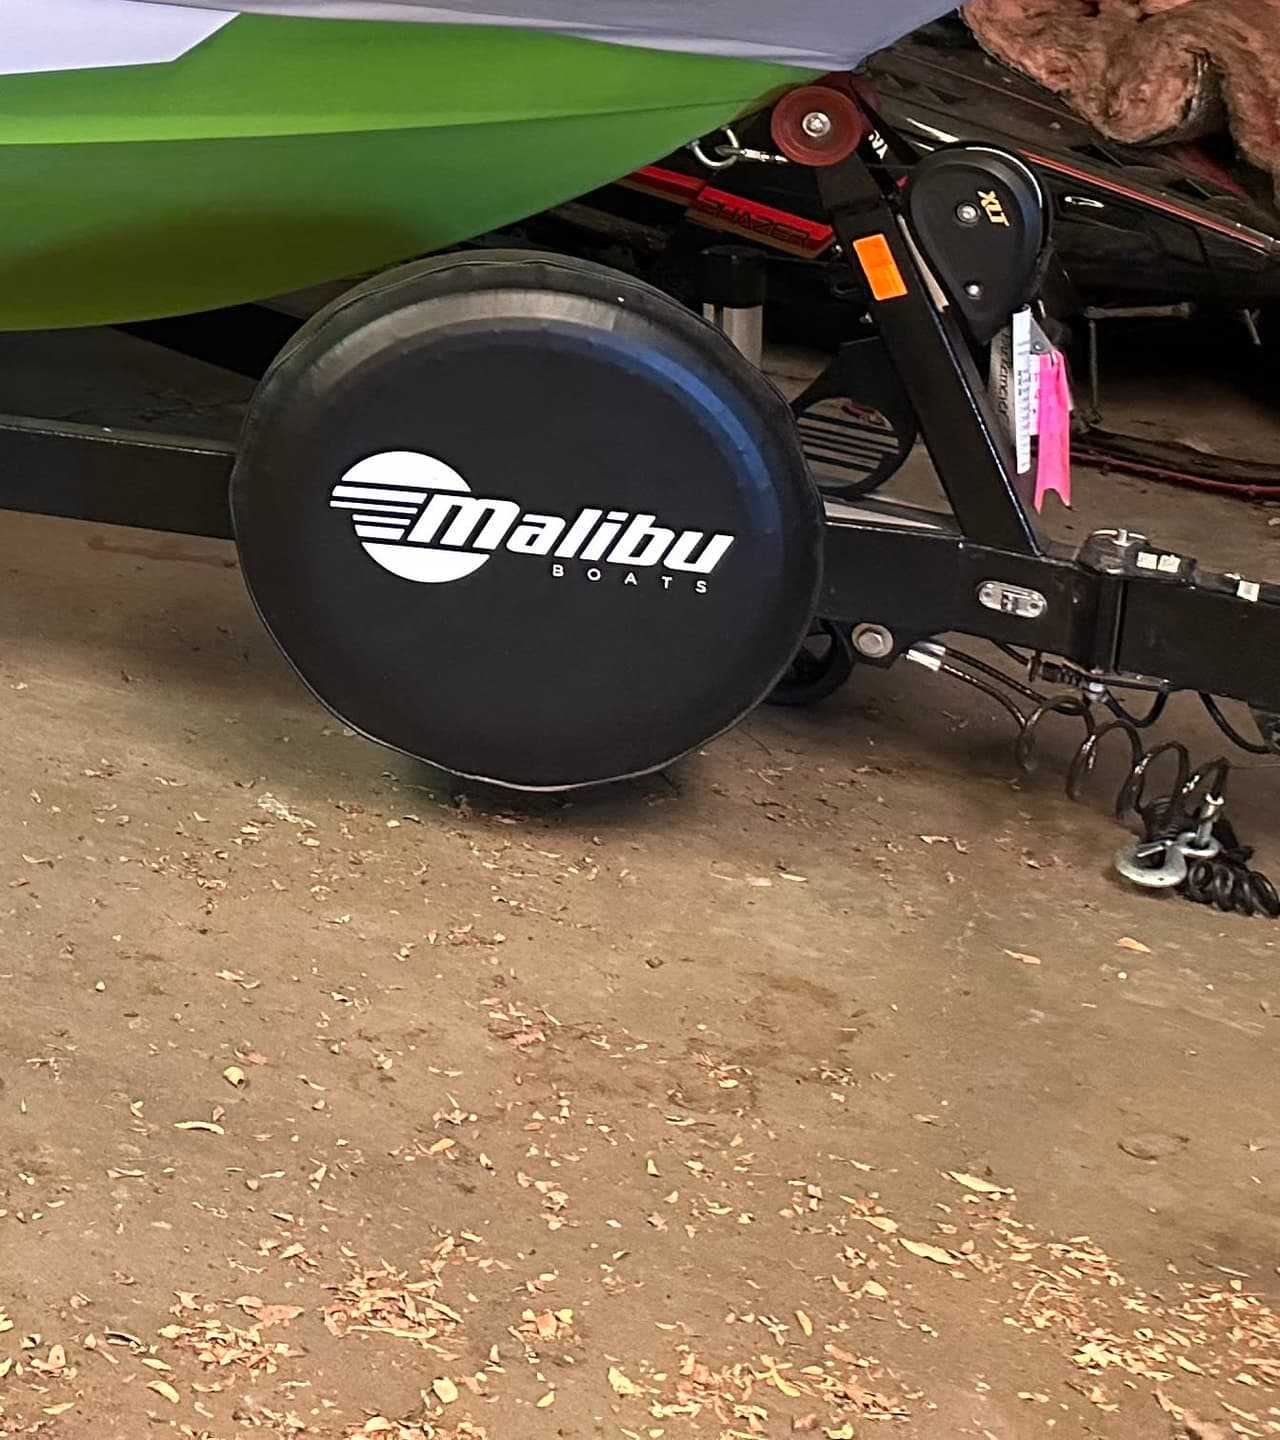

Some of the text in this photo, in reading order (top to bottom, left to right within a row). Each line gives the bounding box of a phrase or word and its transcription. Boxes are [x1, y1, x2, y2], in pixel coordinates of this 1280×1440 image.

[976, 190, 1010, 227] XLT
[406, 492, 735, 574] Malibu
[552, 564, 708, 594] BOATS
